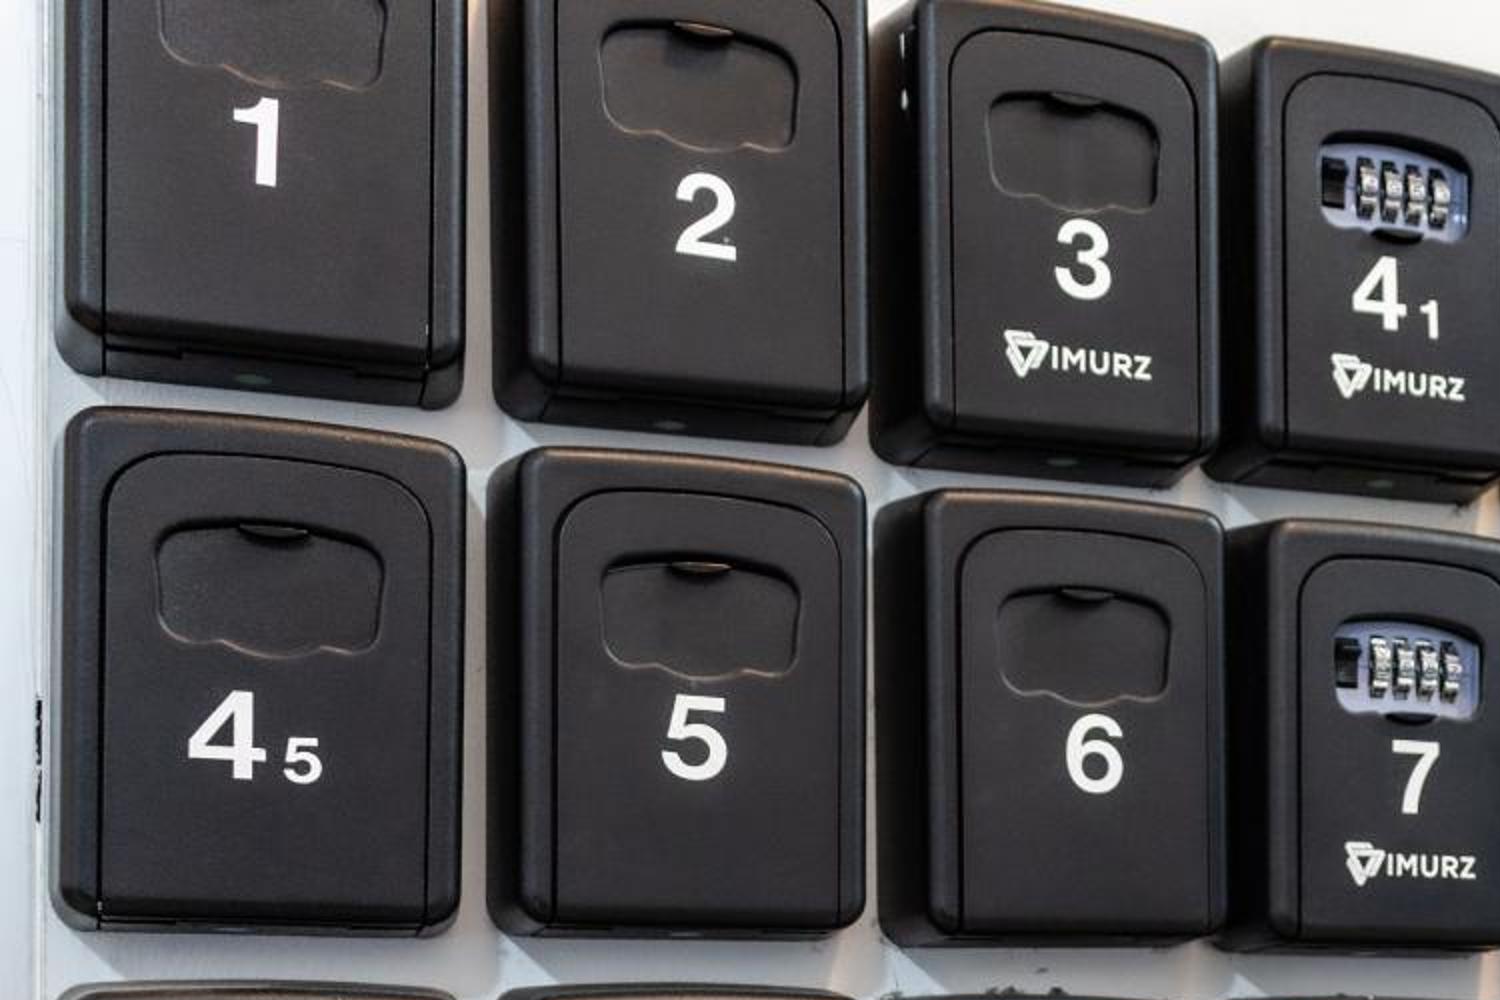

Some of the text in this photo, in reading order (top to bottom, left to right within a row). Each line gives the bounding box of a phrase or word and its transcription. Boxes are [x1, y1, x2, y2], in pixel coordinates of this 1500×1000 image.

[232, 96, 280, 188] 1
[675, 172, 737, 262] 2
[1054, 218, 1112, 300] 3
[661, 693, 728, 781] 5
[1066, 713, 1124, 794] 6
[1392, 739, 1440, 814] 7
